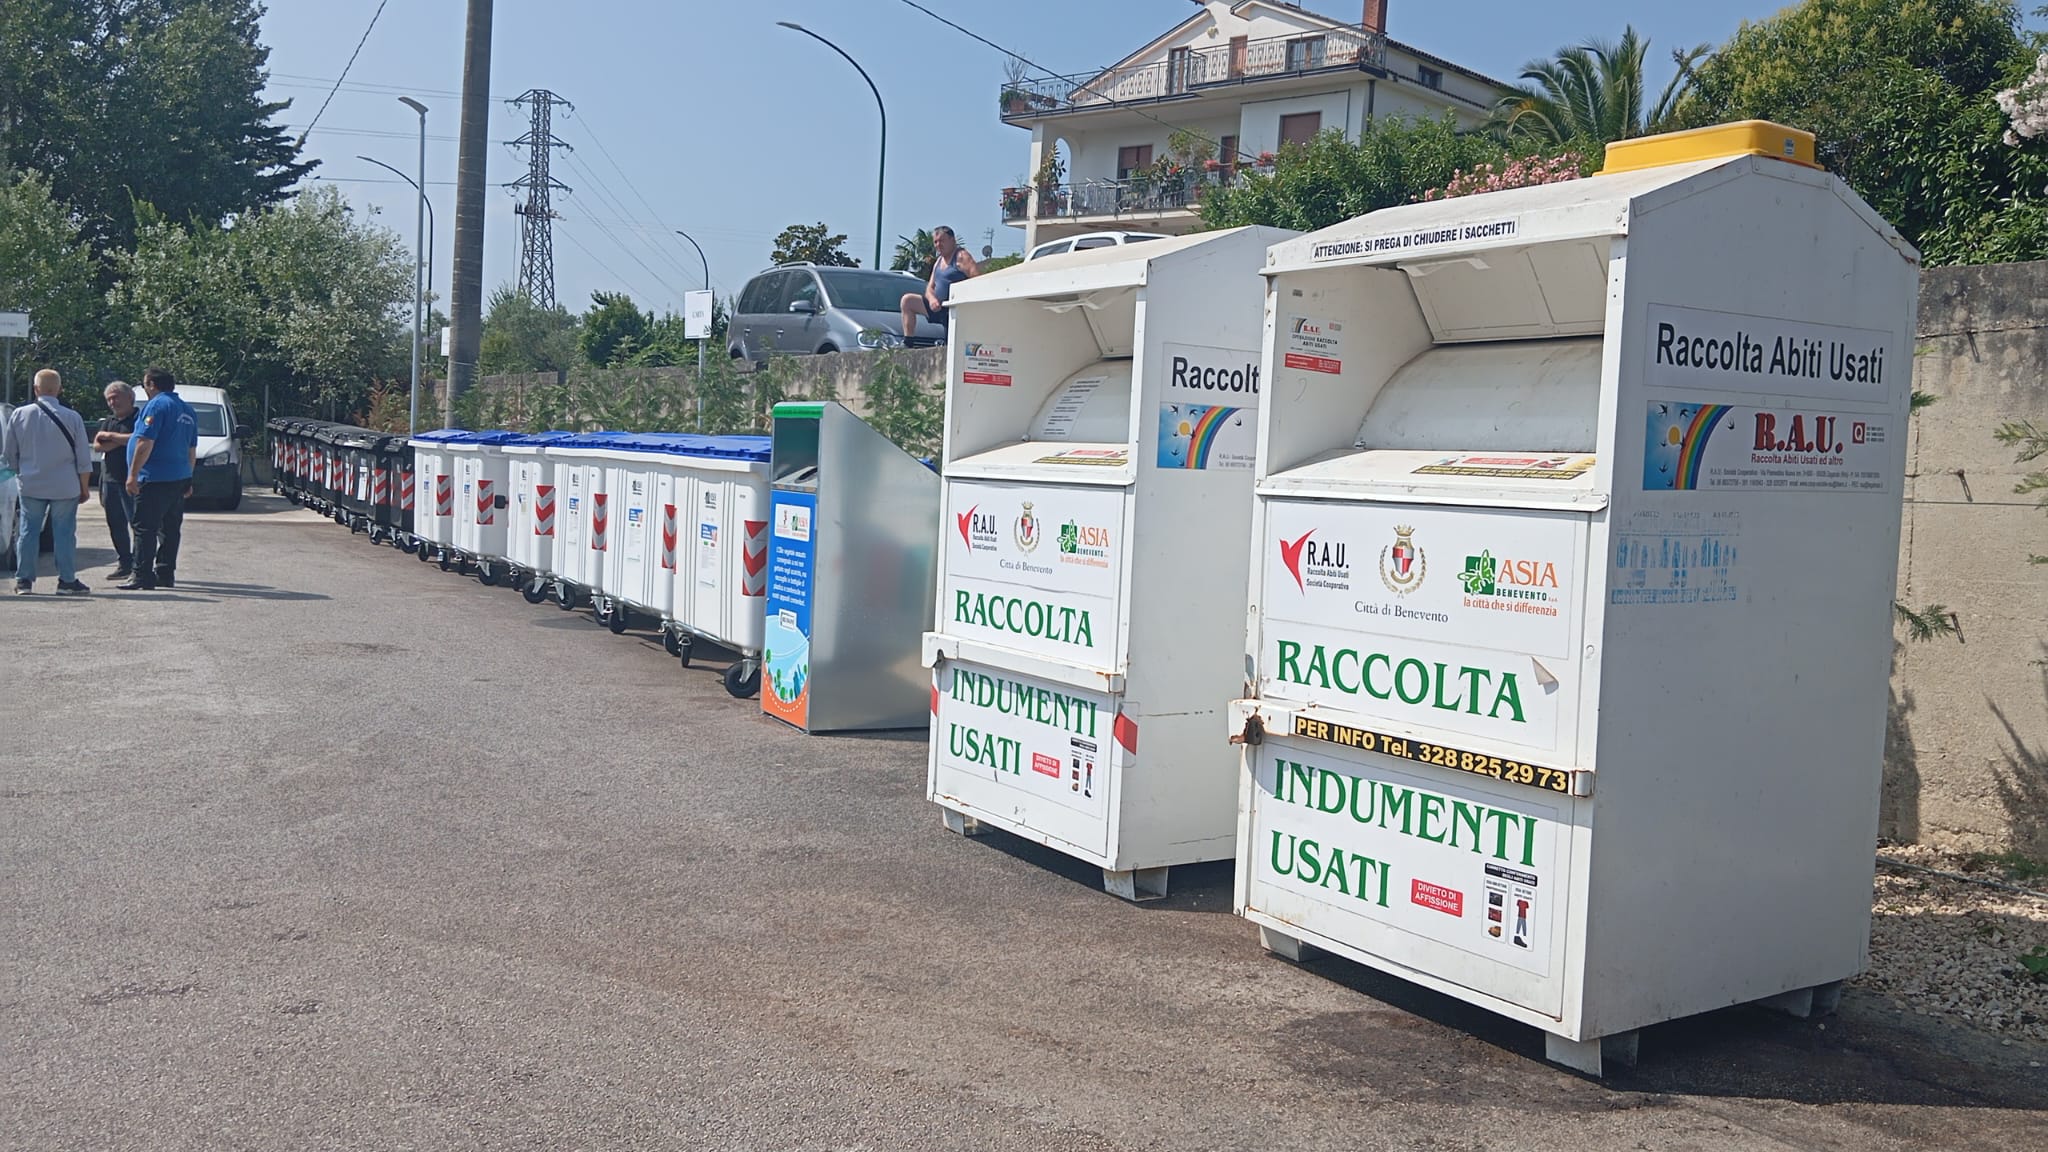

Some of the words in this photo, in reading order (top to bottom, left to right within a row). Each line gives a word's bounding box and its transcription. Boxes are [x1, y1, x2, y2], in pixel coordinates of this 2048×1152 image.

[1314, 241, 1363, 258] ATTENZIONE:
[1364, 239, 1373, 251] SI
[1374, 236, 1401, 251] PREGA
[1403, 235, 1412, 246] DI
[1413, 228, 1457, 246] CHIUDERE
[1459, 228, 1463, 240] I
[1464, 221, 1516, 240] SACCHETTI
[1656, 322, 1763, 374] Raccolta
[1769, 335, 1823, 378] Abiti
[1829, 341, 1884, 384] Usati
[1171, 356, 1260, 394] Raccolt
[1753, 412, 1844, 454] R.A.U.
[1751, 453, 1782, 464] Raccolta
[1783, 454, 1799, 464] Abiti
[1800, 455, 1818, 465] Usati
[1819, 455, 1828, 465] ed
[1828, 455, 1843, 466] altro
[973, 513, 998, 535] R.A.U.
[1078, 526, 1109, 547] ASIA
[1022, 561, 1053, 574] Benevento
[1308, 541, 1349, 568] R.A.U.
[1497, 559, 1558, 588] ASIA
[1463, 596, 1471, 607] la
[1472, 597, 1490, 609] città
[1491, 599, 1505, 611] che
[1506, 601, 1513, 612] si
[1514, 600, 1557, 617] differenzia
[1496, 588, 1547, 601] BENEVENTO
[955, 589, 1094, 648] RACCOLTA
[1354, 600, 1378, 614] Città
[1381, 603, 1391, 615] di
[1394, 604, 1449, 623] Benevento
[1276, 639, 1527, 723] RACCOLTA
[952, 667, 1098, 739] INDUMENTI
[950, 722, 1022, 776] USATI
[1296, 718, 1329, 740] PER
[1333, 725, 1376, 750] INFO
[1380, 735, 1413, 758] Tel.
[1273, 758, 1538, 868] INDUMENTI
[1270, 829, 1392, 909] USATI
[1415, 891, 1459, 911] AFFISSIONE
[1417, 882, 1447, 898] DIVIETO
[1448, 891, 1457, 901] DI
